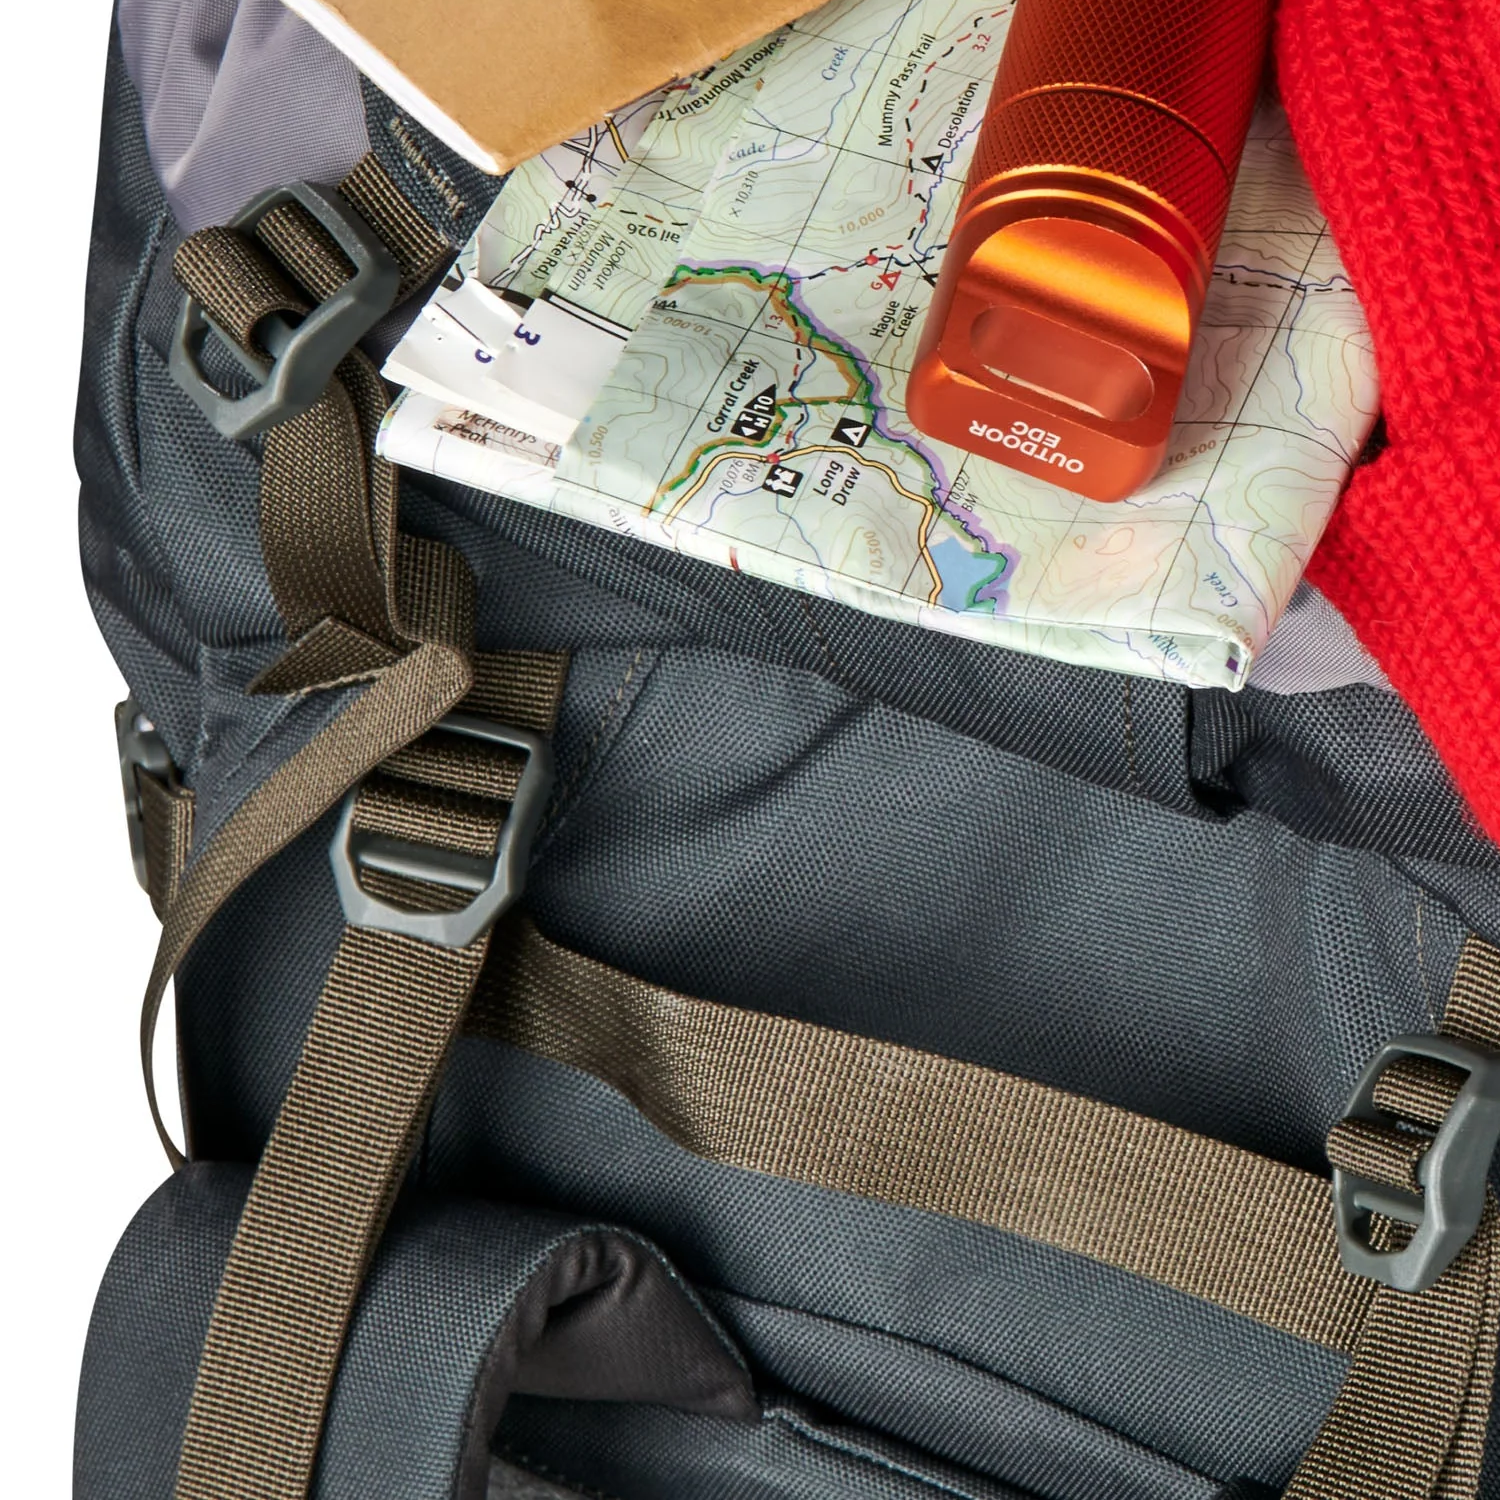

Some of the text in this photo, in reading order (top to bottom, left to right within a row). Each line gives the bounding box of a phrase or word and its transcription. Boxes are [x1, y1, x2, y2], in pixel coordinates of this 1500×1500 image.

[972, 33, 992, 52] 3.2
[821, 45, 849, 81] Creek
[676, 68, 744, 117] Mountain
[878, 33, 936, 147] Mummy Pass Trail
[938, 81, 980, 149] Desolation
[627, 222, 657, 238] 926
[838, 207, 885, 235] 10,000
[530, 212, 591, 280] (Private Rd.)
[568, 230, 611, 292] Mountain
[592, 238, 633, 291] Lookout
[663, 315, 712, 336] 10,000
[764, 314, 784, 331] 1.3
[869, 300, 900, 338] Hague
[892, 304, 919, 338] Creek
[707, 358, 760, 433] Corral Creek
[449, 422, 490, 446] Peak
[458, 409, 537, 444] McHenrys
[1010, 421, 1062, 449] EDC
[588, 425, 609, 466] 10,500
[968, 419, 1085, 474] OUTDOOR
[1167, 439, 1217, 466] 10,500
[719, 458, 744, 493] 10,076
[743, 462, 760, 483] BM
[813, 459, 844, 497] Long
[831, 466, 861, 507] Draw
[962, 492, 979, 513] BM
[863, 530, 884, 576] 10,500
[1202, 571, 1239, 608] Creek
